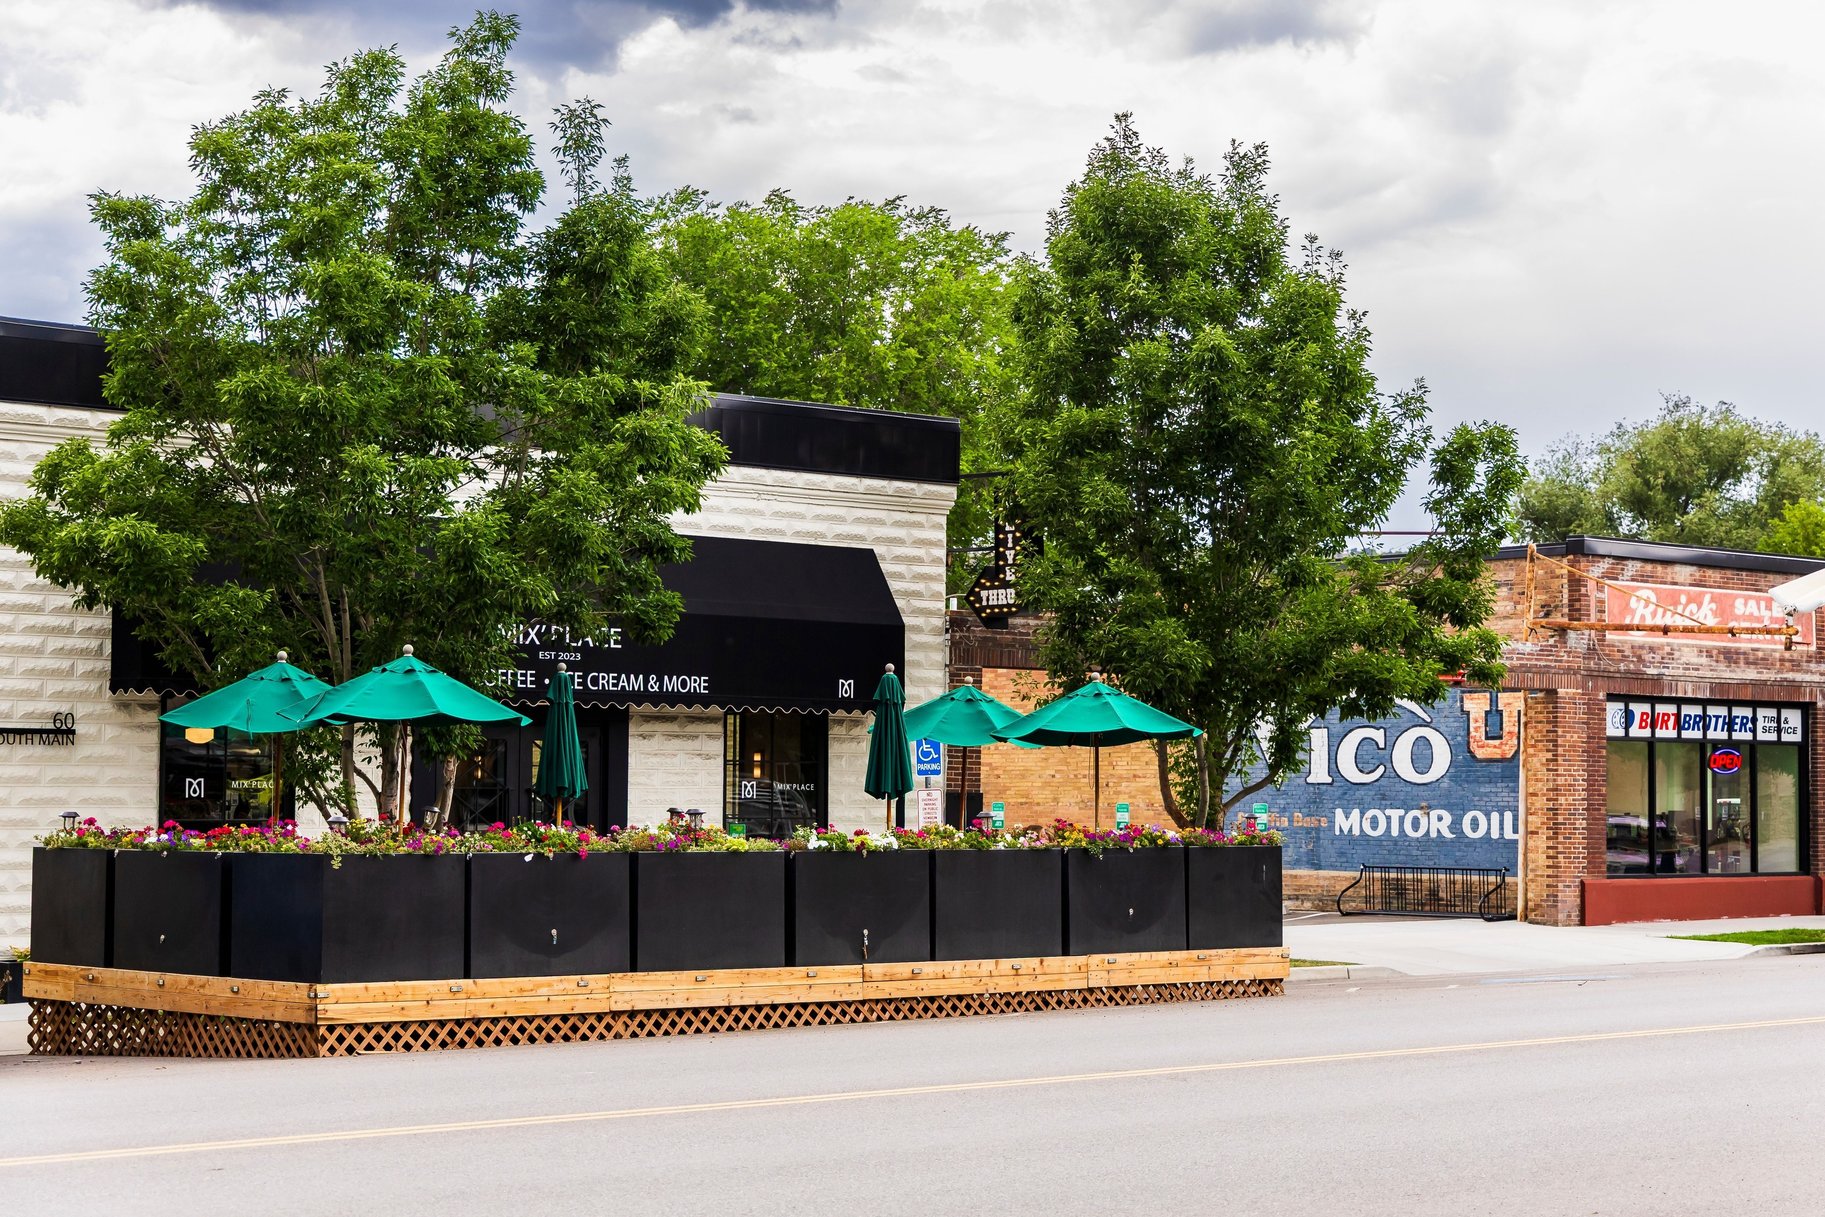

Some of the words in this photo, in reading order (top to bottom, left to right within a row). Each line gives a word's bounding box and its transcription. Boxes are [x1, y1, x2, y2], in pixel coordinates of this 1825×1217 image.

[1005, 520, 1016, 581] IVE
[539, 651, 556, 660] EST
[558, 652, 581, 661] 2023
[484, 669, 536, 688] OFFEE
[587, 673, 644, 692] CREAM
[648, 675, 659, 692] &
[663, 675, 709, 693] MORE
[53, 712, 75, 729] 60
[1638, 711, 1679, 731] BURT
[1681, 713, 1758, 733] BROTHERS
[1783, 717, 1790, 725] &
[38, 734, 75, 746] MAIN
[917, 763, 941, 771] PARKING
[1710, 754, 1742, 768] OPEN
[1334, 808, 1456, 839] MOTOR
[1462, 810, 1520, 840] OIL
